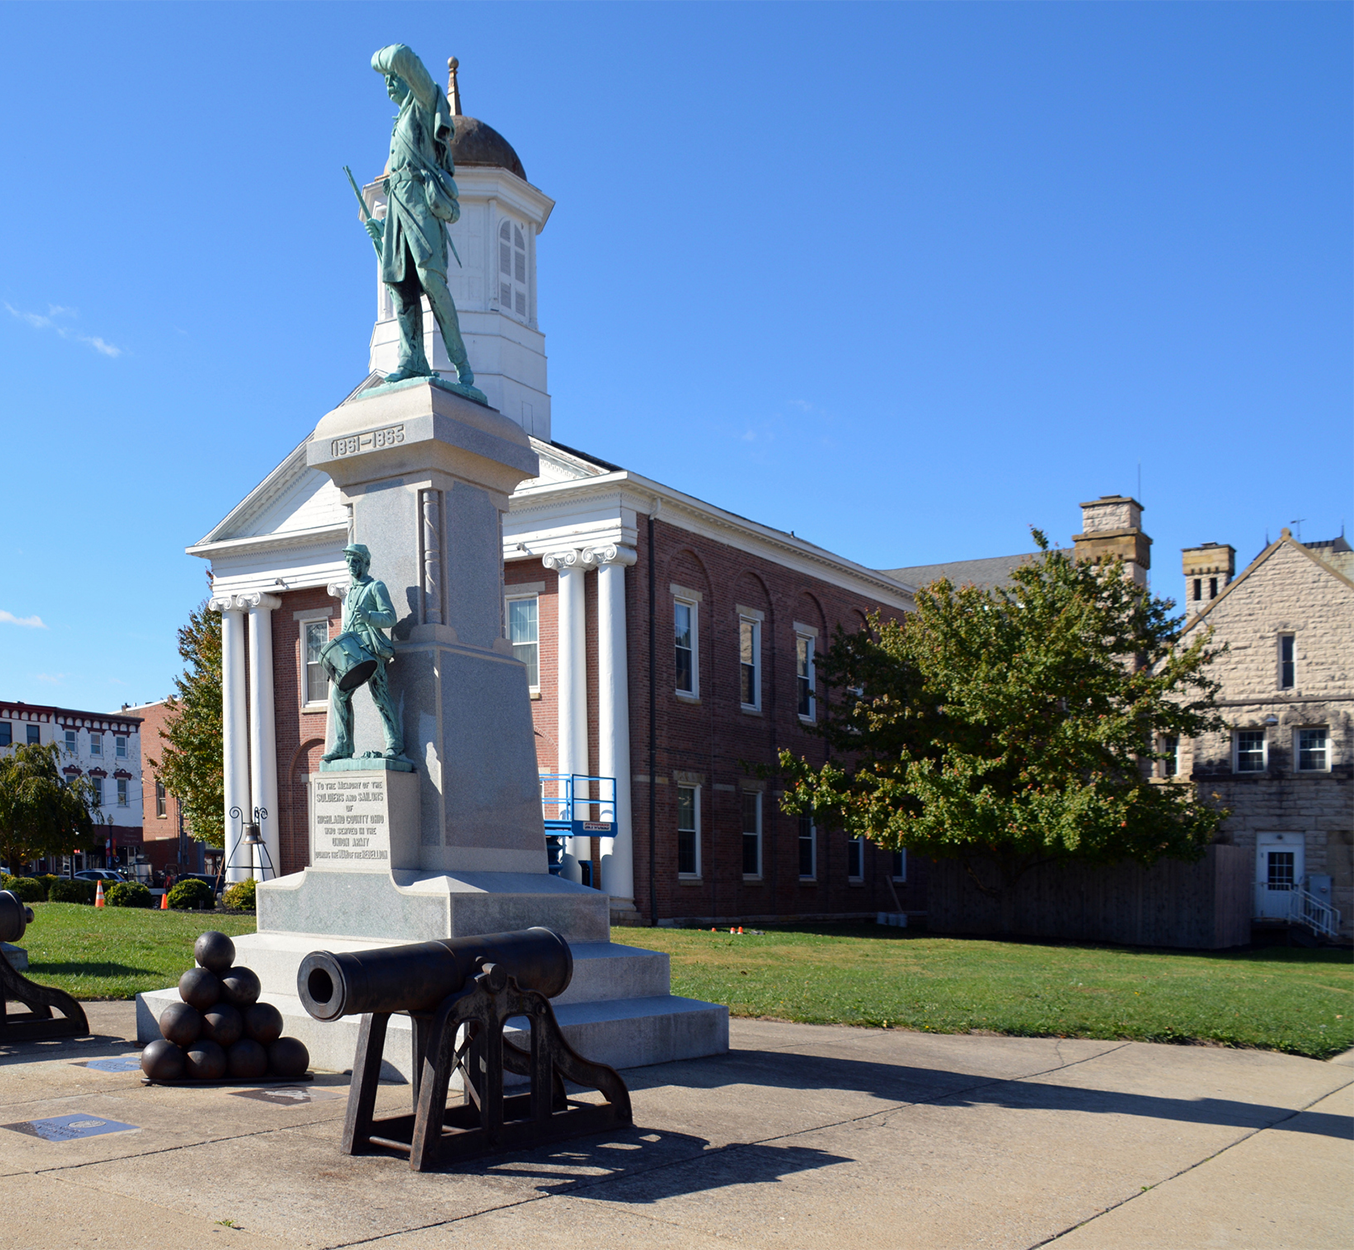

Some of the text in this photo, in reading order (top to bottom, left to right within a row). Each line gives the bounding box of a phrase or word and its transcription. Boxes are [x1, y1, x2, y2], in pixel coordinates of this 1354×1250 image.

[326, 782, 336, 790] THE
[338, 781, 361, 790] MEMORY
[372, 781, 382, 789] THE
[316, 793, 344, 802] SOLDIERS
[358, 792, 384, 802] SAILORS
[317, 815, 384, 824] HIGHLAND COUNTY OHIO
[332, 838, 370, 847] UNION ARMY
